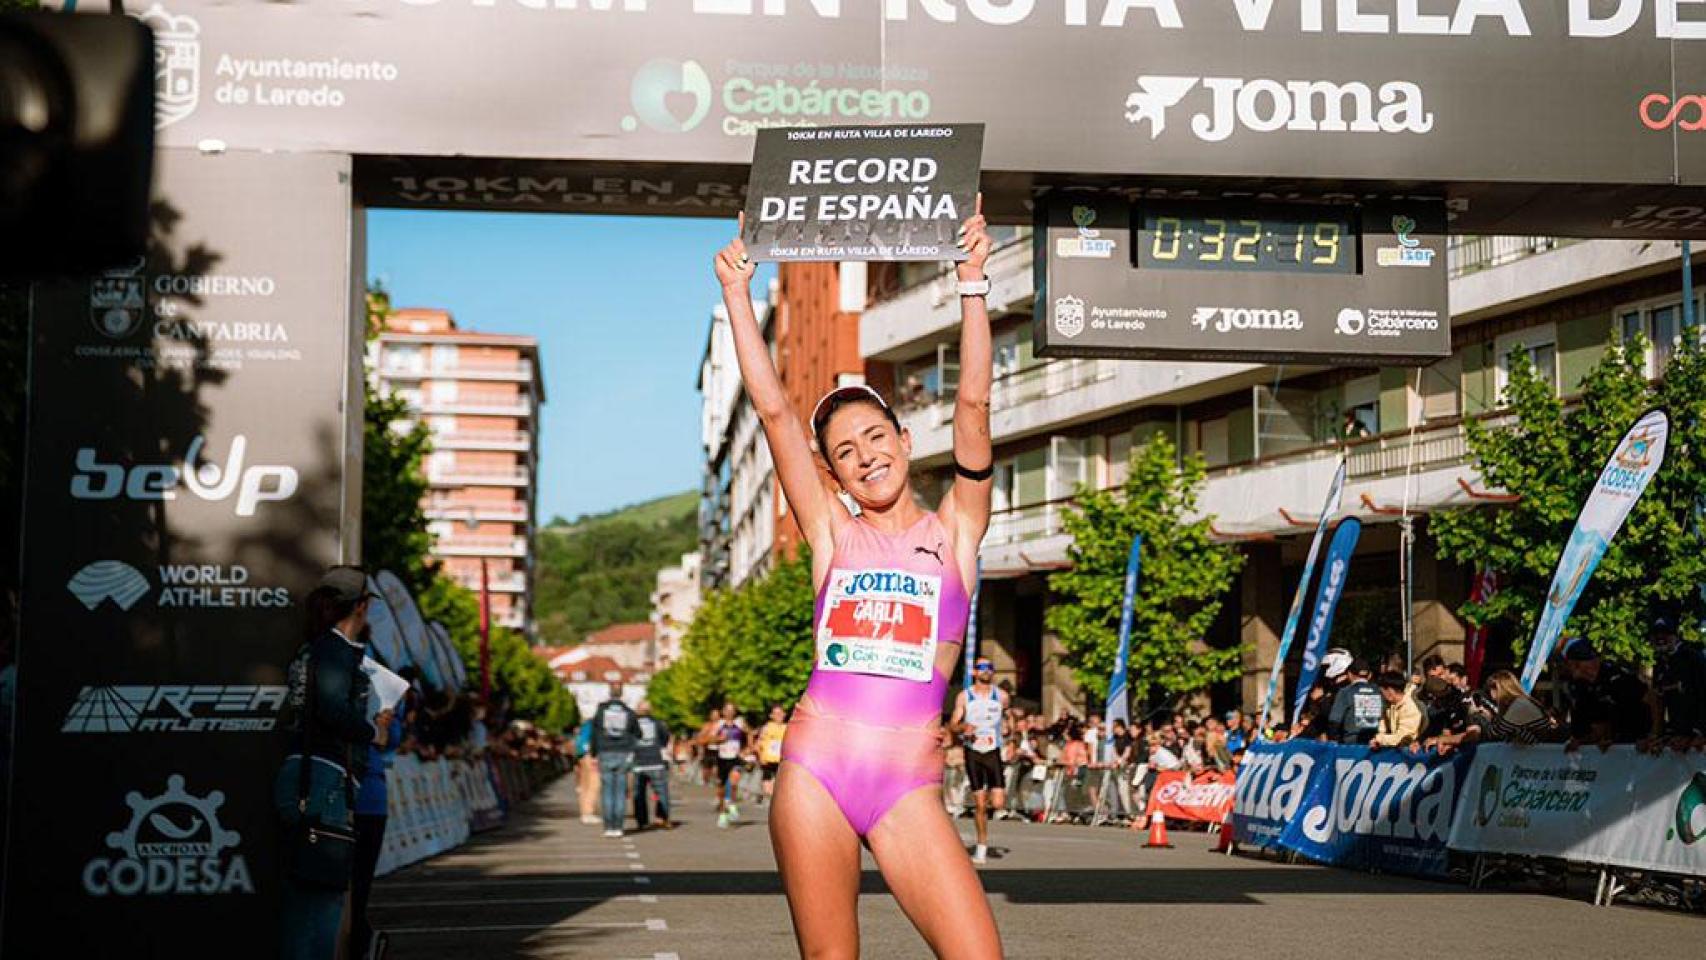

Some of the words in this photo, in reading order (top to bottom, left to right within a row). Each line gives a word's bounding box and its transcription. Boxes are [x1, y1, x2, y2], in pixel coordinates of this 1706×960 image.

[216, 53, 398, 81] Ayuntamiento
[215, 81, 249, 104] de
[256, 83, 345, 106] Laredo
[723, 77, 930, 118] Cabárceno
[787, 131, 815, 141] 10KM
[818, 131, 832, 139] EN
[834, 130, 861, 139] RUTA
[862, 129, 892, 138] VILLA
[894, 128, 908, 137] DE
[910, 128, 953, 137] LAREDO
[789, 157, 938, 185] RECORD
[760, 196, 808, 222] DE
[817, 186, 958, 221] ESPAÑA
[1152, 216, 1339, 264] 0:32:19
[769, 247, 798, 257] 10KM
[801, 247, 815, 256] EN
[817, 246, 845, 256] RUTA
[848, 246, 877, 255] VILLA
[154, 275, 275, 295] GOBIERNO
[154, 297, 177, 316] de
[1091, 306, 1167, 319] Ayuntamiento
[154, 321, 288, 341] CANTABRIA
[1091, 318, 1105, 329] de
[1108, 319, 1145, 330] Laredo
[159, 565, 248, 585] WORLD
[853, 600, 904, 624] CARLA
[147, 685, 289, 718] RFEA
[138, 718, 277, 731] ATLETISMO
[83, 855, 255, 896] CODESA
